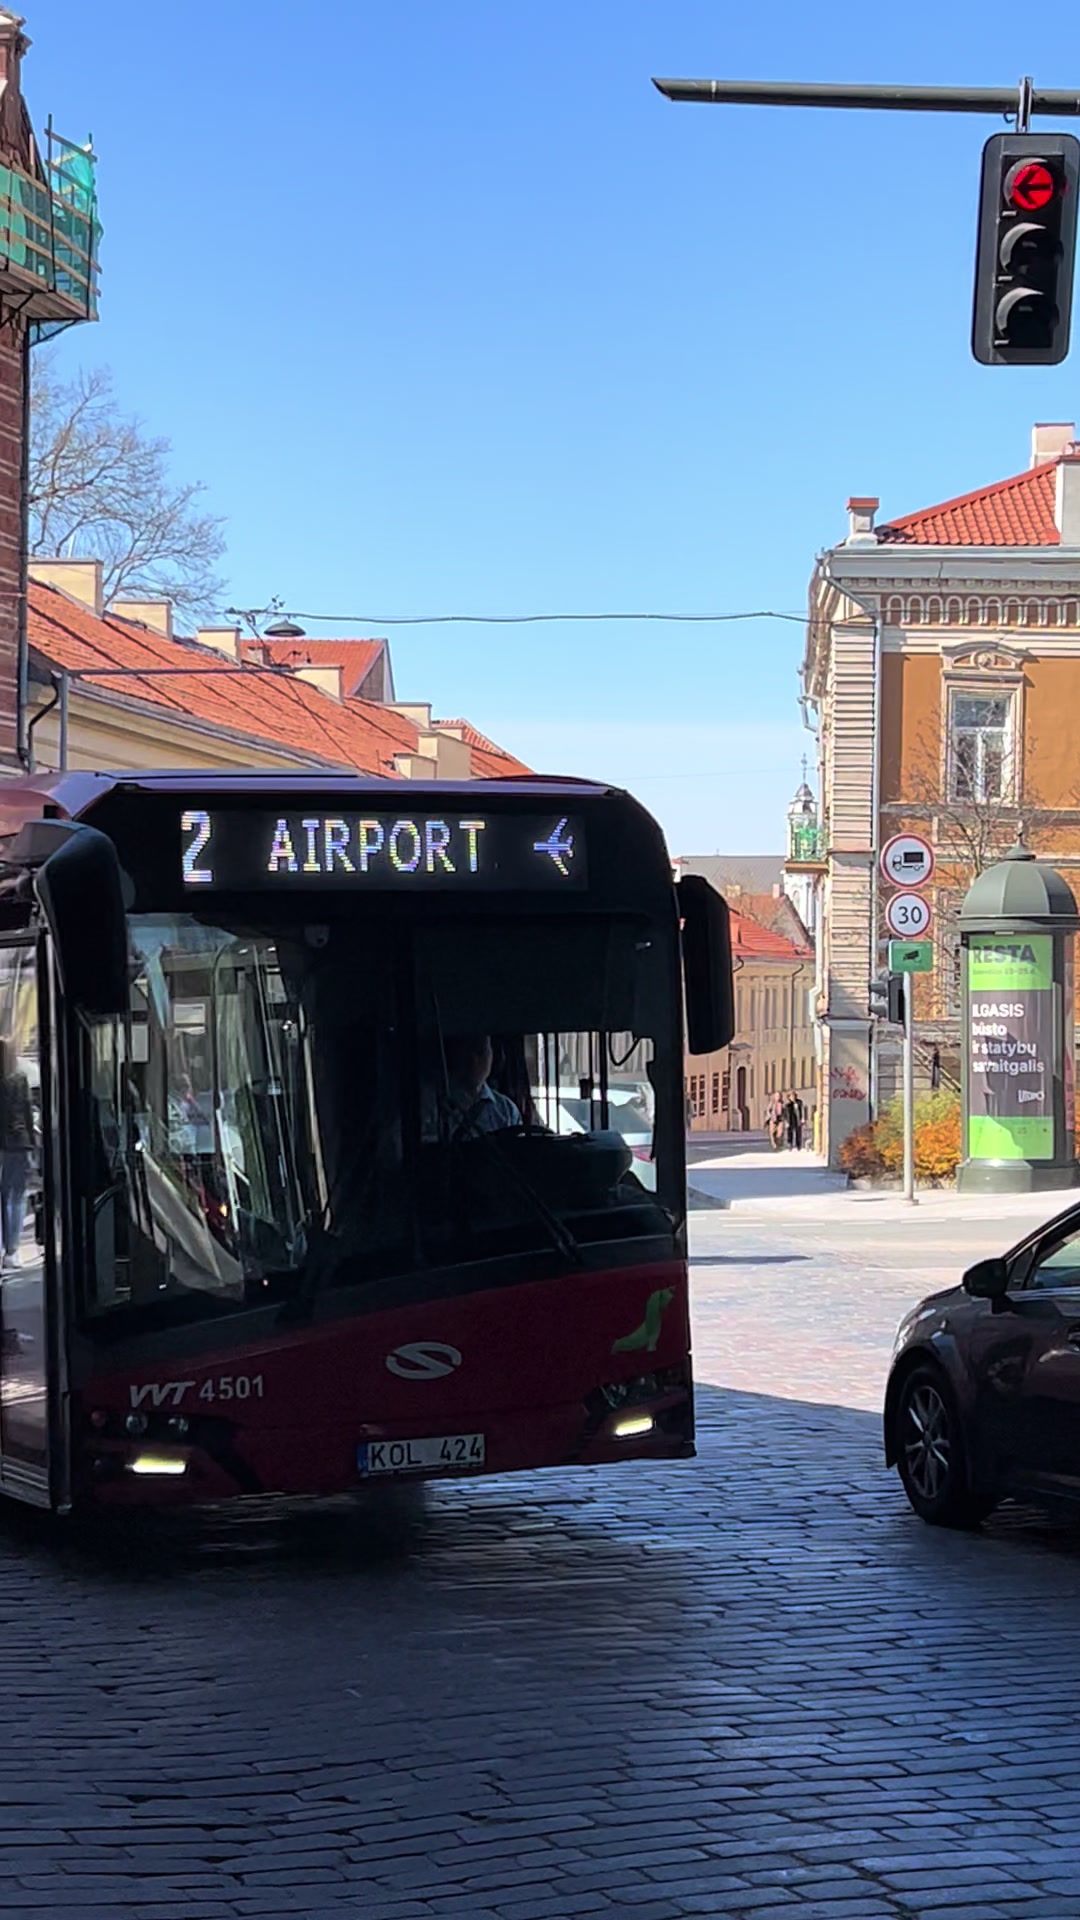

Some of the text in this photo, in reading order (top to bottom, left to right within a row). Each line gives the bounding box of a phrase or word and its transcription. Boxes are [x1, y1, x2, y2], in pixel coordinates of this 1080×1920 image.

[181, 811, 486, 883] 2 AIRPORT
[898, 905, 922, 924] 30
[972, 944, 1037, 963] RESTA
[971, 1040, 980, 1054] ir
[129, 1375, 264, 1408] VVT 4501
[370, 1437, 482, 1468] KOL 424
